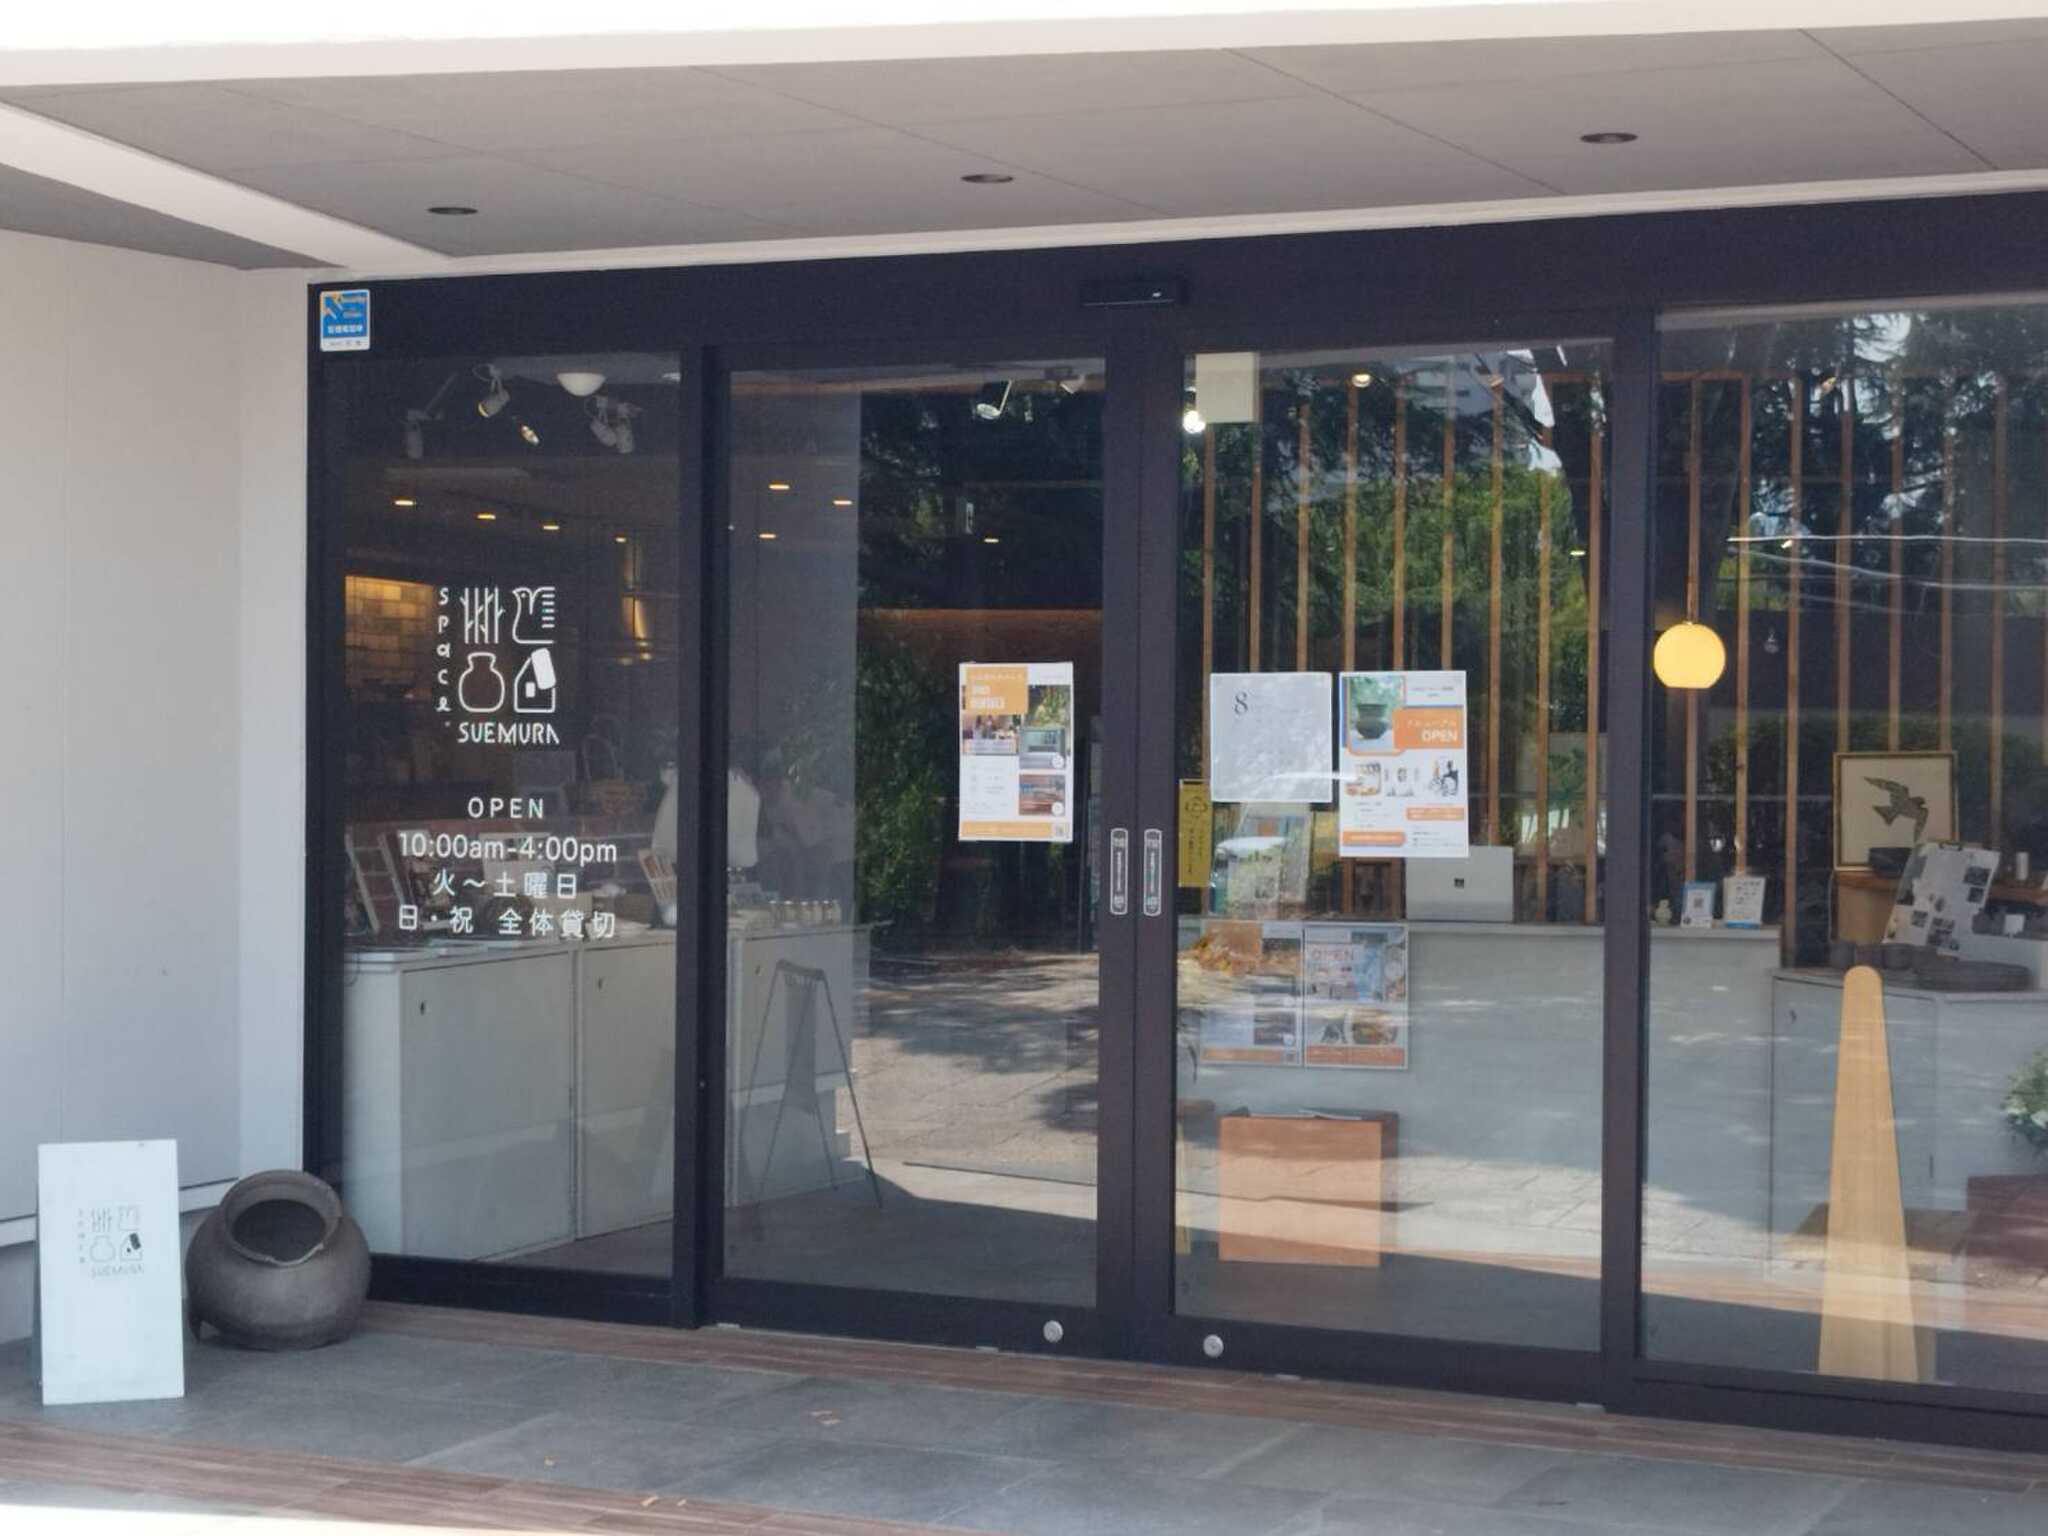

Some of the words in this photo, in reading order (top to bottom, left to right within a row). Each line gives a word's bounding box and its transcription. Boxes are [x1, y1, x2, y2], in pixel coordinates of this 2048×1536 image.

[1233, 690, 1249, 715] 8
[457, 721, 561, 746] SUEMURA
[1421, 728, 1459, 743] OPEN
[467, 796, 545, 819] OPEN
